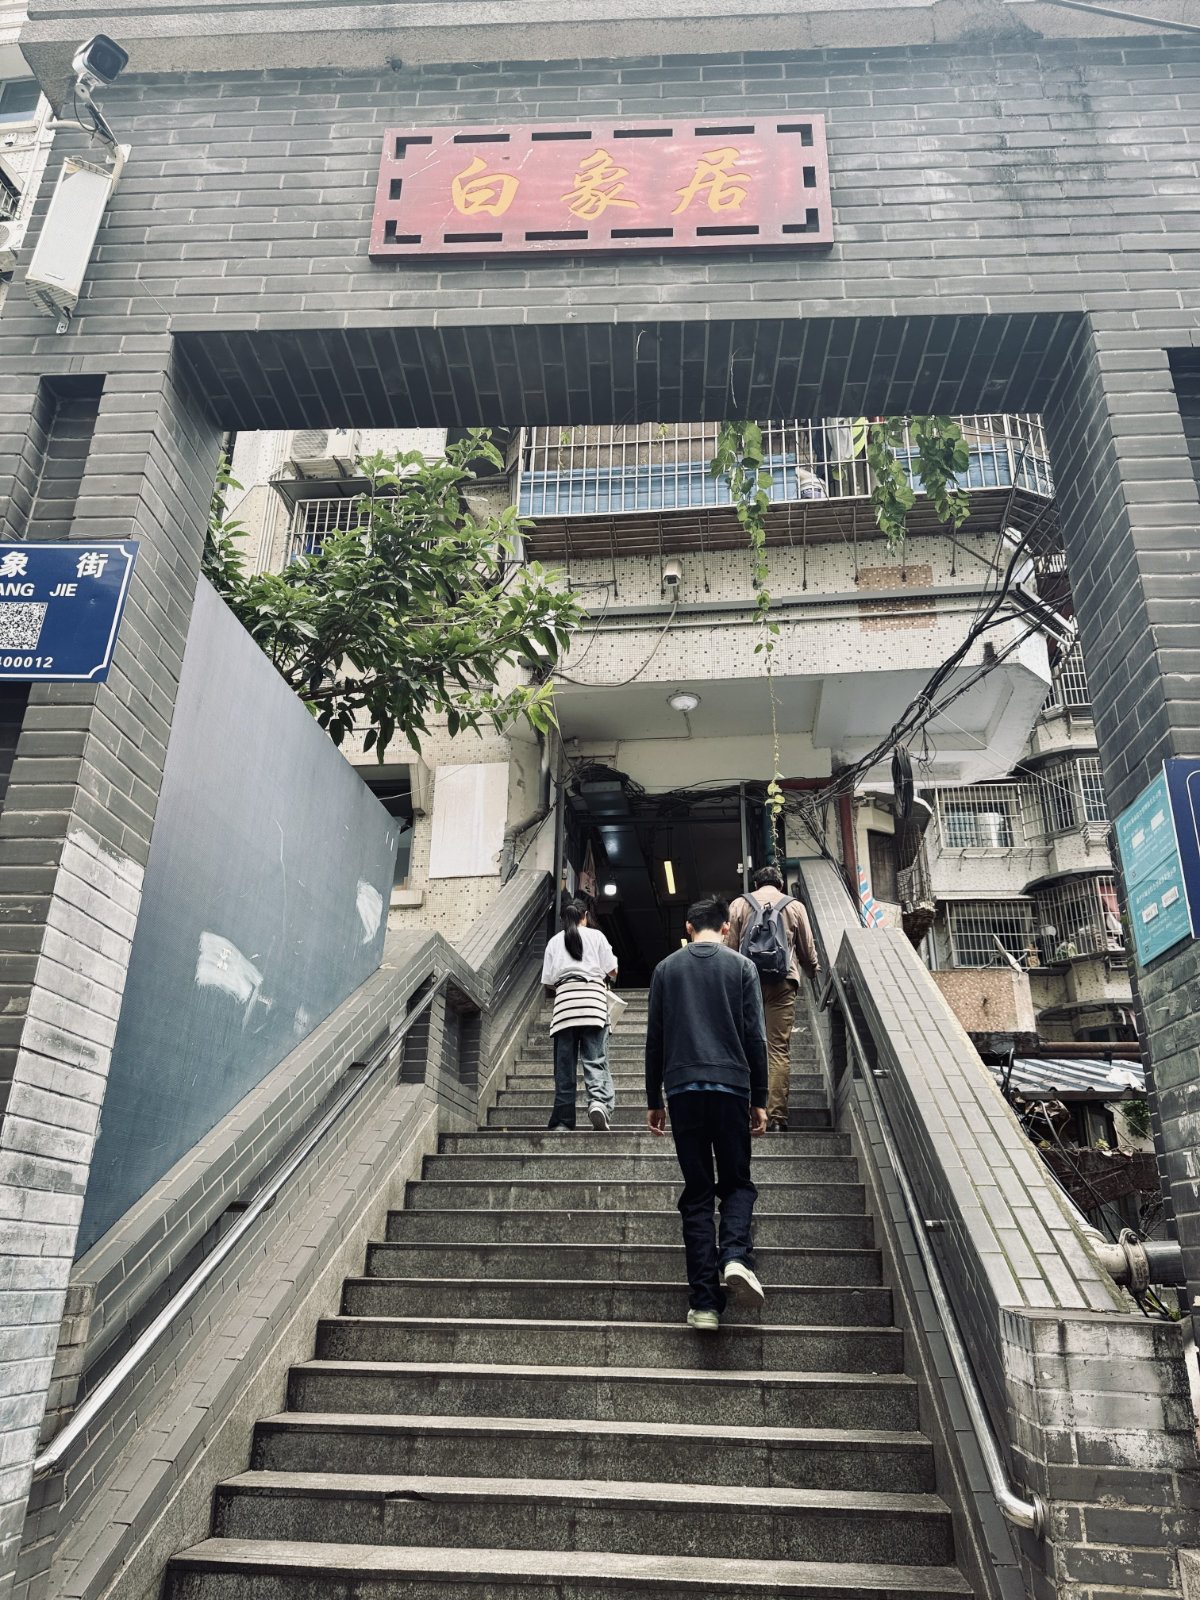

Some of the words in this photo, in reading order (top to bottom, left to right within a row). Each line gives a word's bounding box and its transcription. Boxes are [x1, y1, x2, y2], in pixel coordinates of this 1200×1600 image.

[451, 147, 752, 220] 白象居
[49, 583, 78, 597] JIE
[0, 656, 54, 668] 00012
